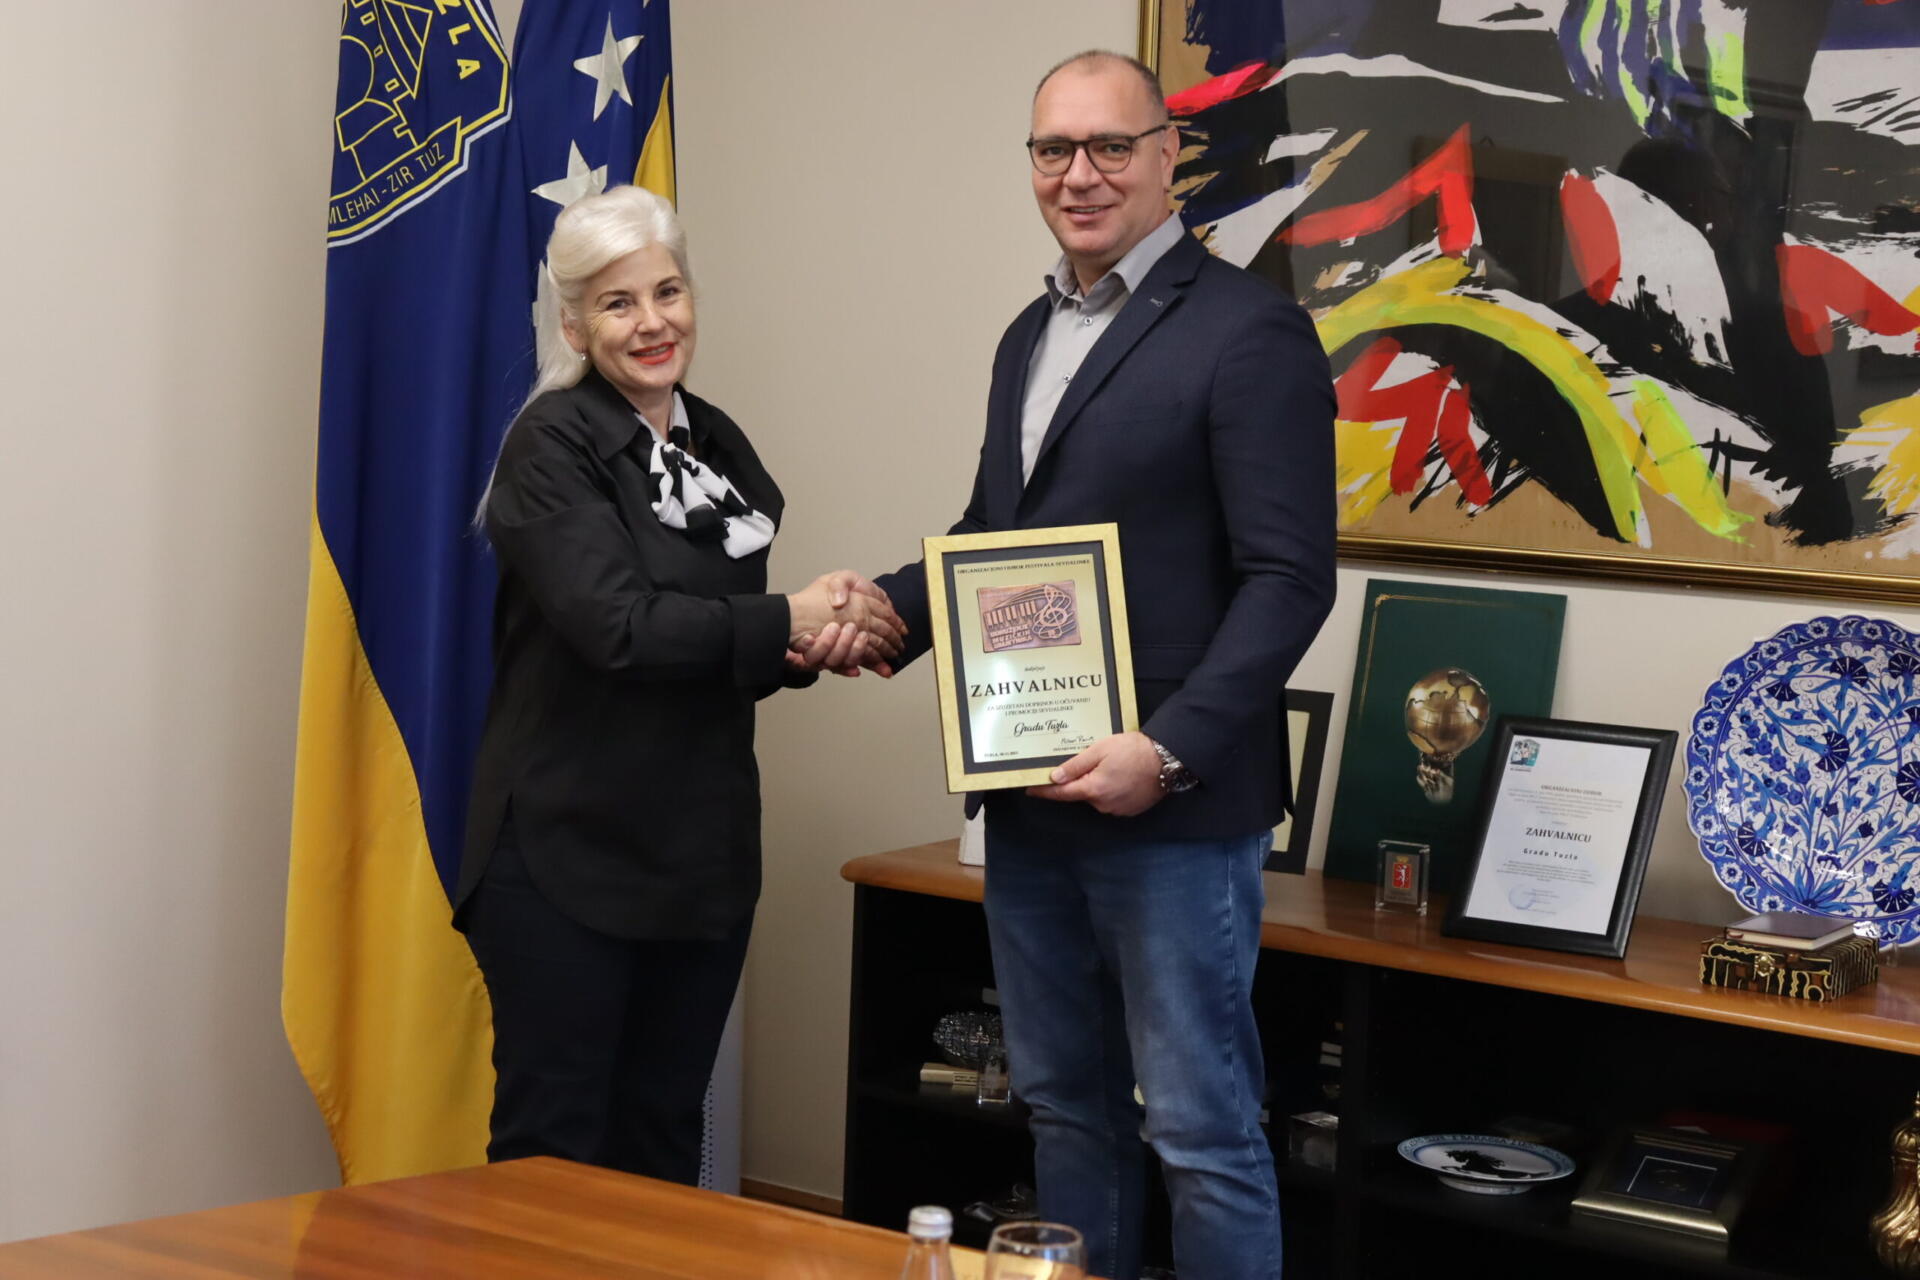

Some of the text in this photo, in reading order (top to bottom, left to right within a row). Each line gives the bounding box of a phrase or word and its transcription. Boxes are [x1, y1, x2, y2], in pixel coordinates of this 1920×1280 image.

[416, 142, 446, 172] TUZ
[970, 674, 1103, 698] ZAHVALNICU
[1044, 718, 1069, 734] Tuzla
[1525, 827, 1592, 843] ZAHVALNICU
